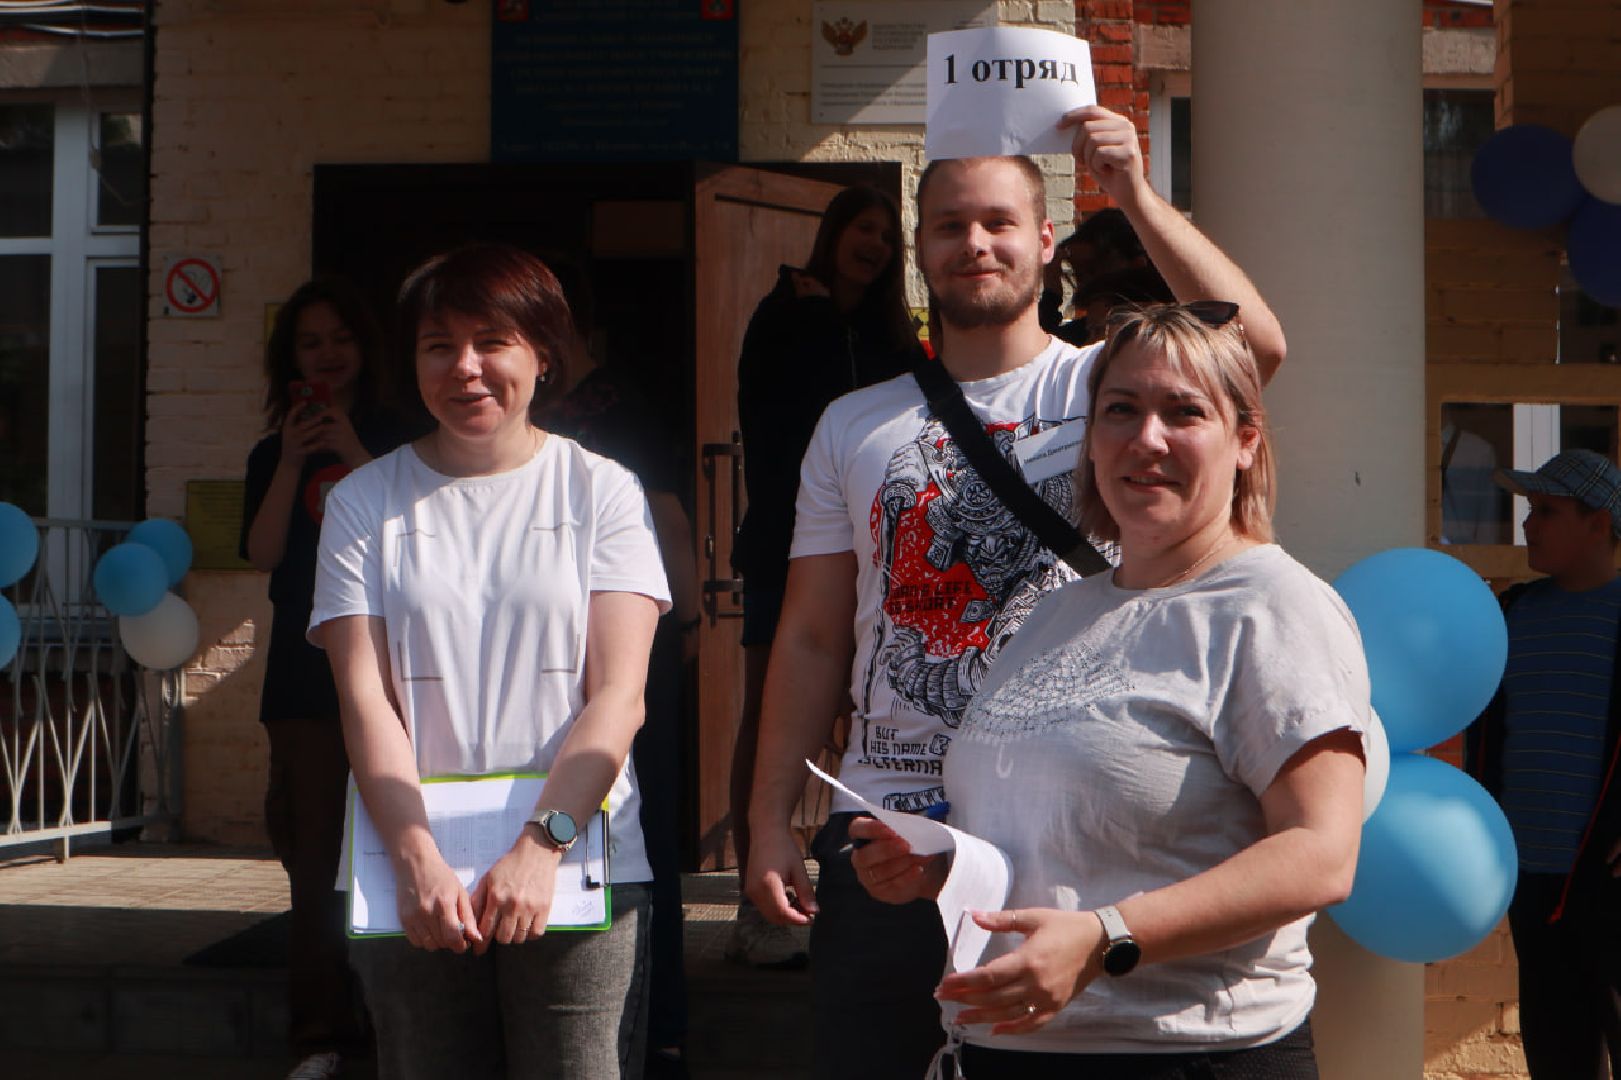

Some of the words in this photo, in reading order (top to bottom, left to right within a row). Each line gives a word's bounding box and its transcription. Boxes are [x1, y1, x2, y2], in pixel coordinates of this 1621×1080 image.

[944, 53, 958, 84] 1
[972, 58, 1079, 89] отряд
[875, 725, 899, 740] BUT
[870, 740, 889, 754] HIS
[892, 743, 927, 755] NAME
